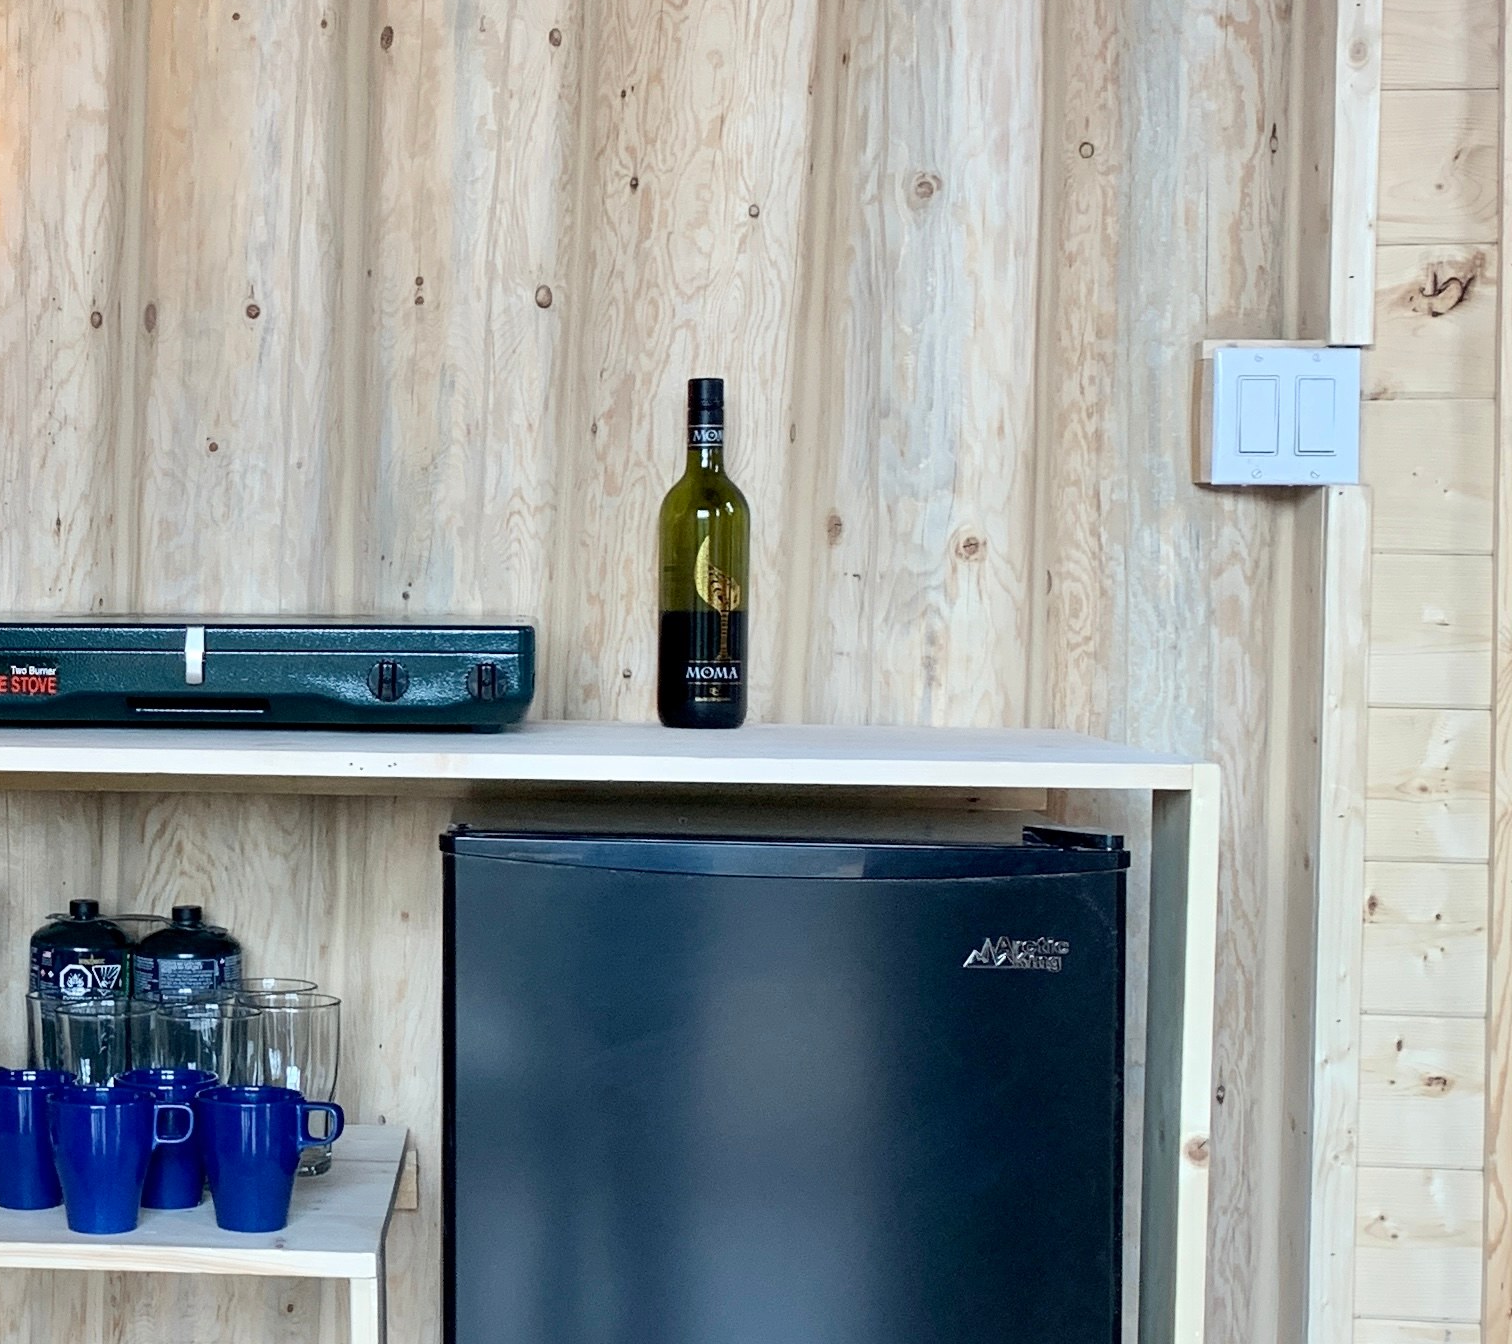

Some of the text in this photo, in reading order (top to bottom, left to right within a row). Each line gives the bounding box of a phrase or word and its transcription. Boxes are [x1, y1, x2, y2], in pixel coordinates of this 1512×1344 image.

[10, 665, 56, 676] Two Burner
[685, 666, 738, 679] MOMA
[11, 676, 57, 694] STOVE
[994, 936, 1070, 955] Arctic
[1014, 953, 1062, 973] King
